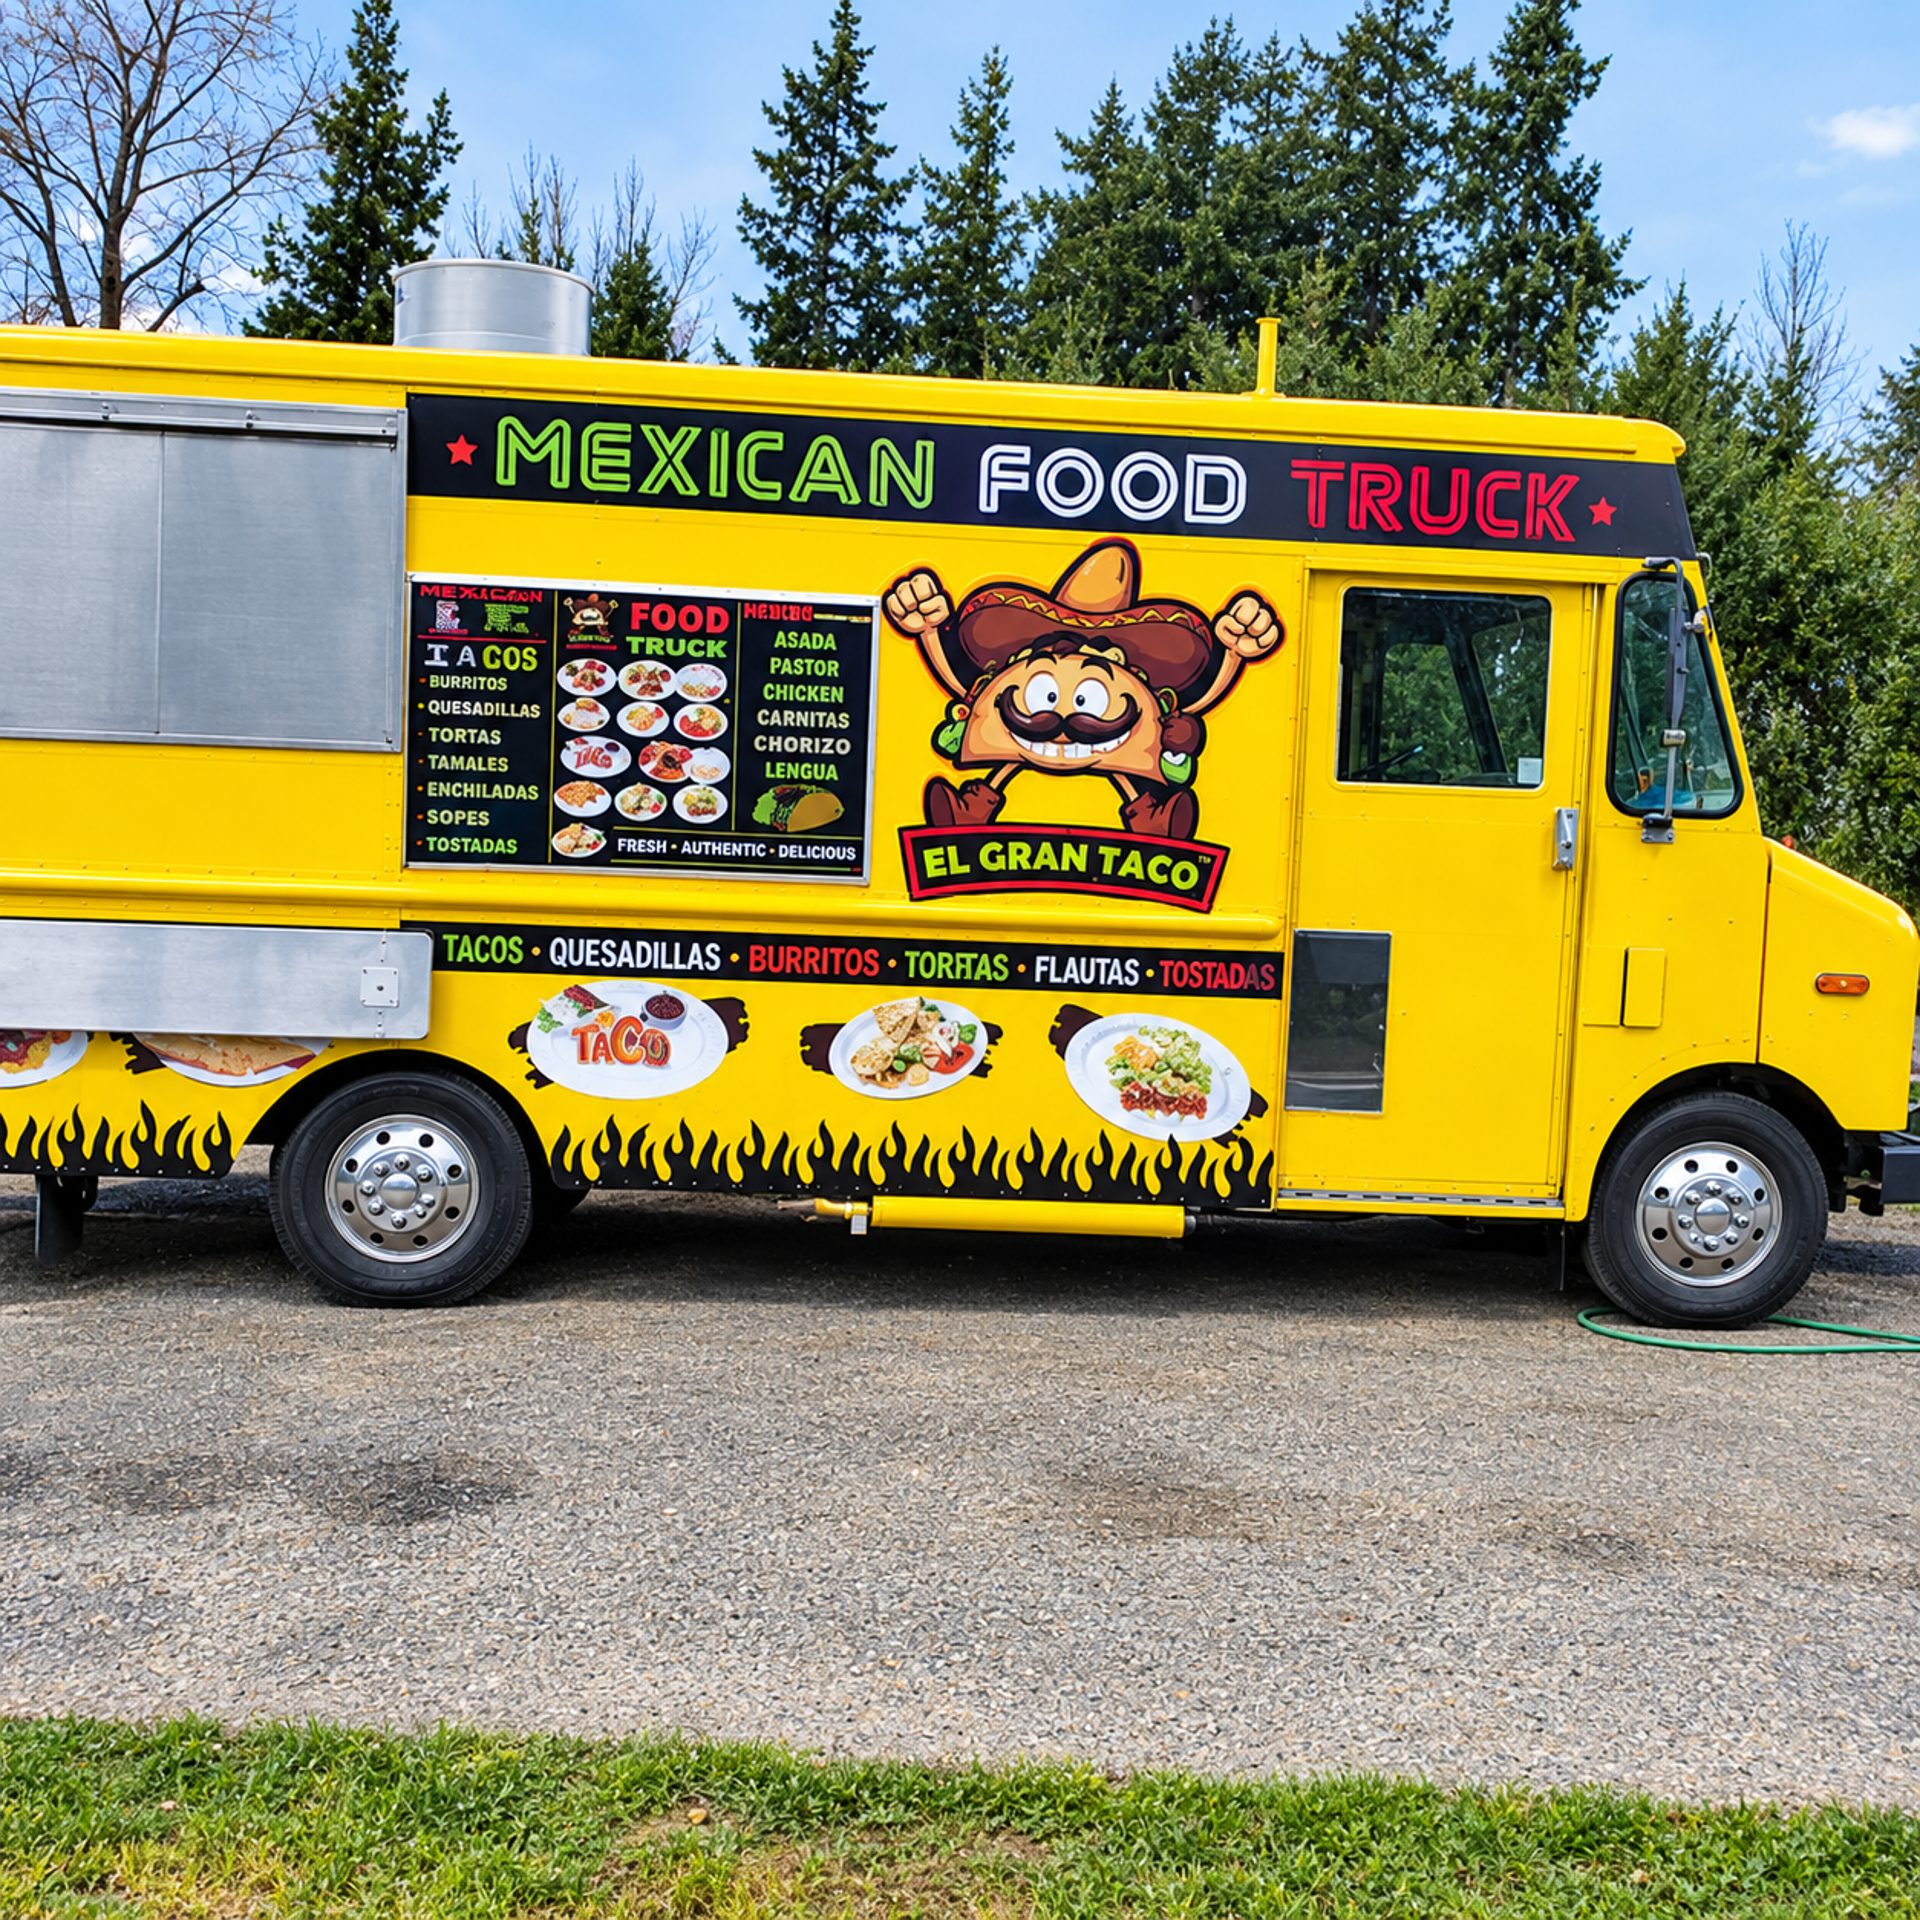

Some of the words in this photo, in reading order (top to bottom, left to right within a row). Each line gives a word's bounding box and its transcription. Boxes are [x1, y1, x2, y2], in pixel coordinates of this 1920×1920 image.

[496, 416, 935, 509] MEXICAN
[978, 444, 1247, 524] FOOD
[1291, 459, 1581, 541] TRUCK
[631, 603, 729, 633] FOOD
[626, 637, 728, 657] TRUCK
[774, 631, 836, 650] ASADA
[770, 657, 839, 677] PASTOR
[429, 675, 507, 691] BURRITOS
[763, 683, 844, 703] CHICKEN
[428, 700, 540, 718] QUESADILLAS
[757, 709, 850, 729] CARNITAS
[428, 727, 501, 745] TORTAS
[754, 735, 851, 755] CHORIZO
[428, 754, 509, 772] TAMALES
[765, 762, 838, 780] LENGUA
[427, 782, 538, 800] ENCHILADAS
[427, 809, 490, 826] SOPES
[426, 837, 517, 854] TOSTADAS
[617, 838, 666, 853] FRESH
[681, 841, 767, 857] AUTHENTIC
[779, 844, 856, 860] DELICIOUS
[923, 846, 970, 878] EL
[980, 842, 1088, 872] GRAN
[1099, 846, 1199, 890] TACO
[443, 935, 523, 964] TACOS
[549, 937, 720, 971] QUESADILLAS
[749, 945, 879, 976] BURRITOS
[1035, 956, 1139, 986] FLAUTAS
[1159, 960, 1276, 991] TOSTADAS
[572, 1015, 671, 1066] TACO
